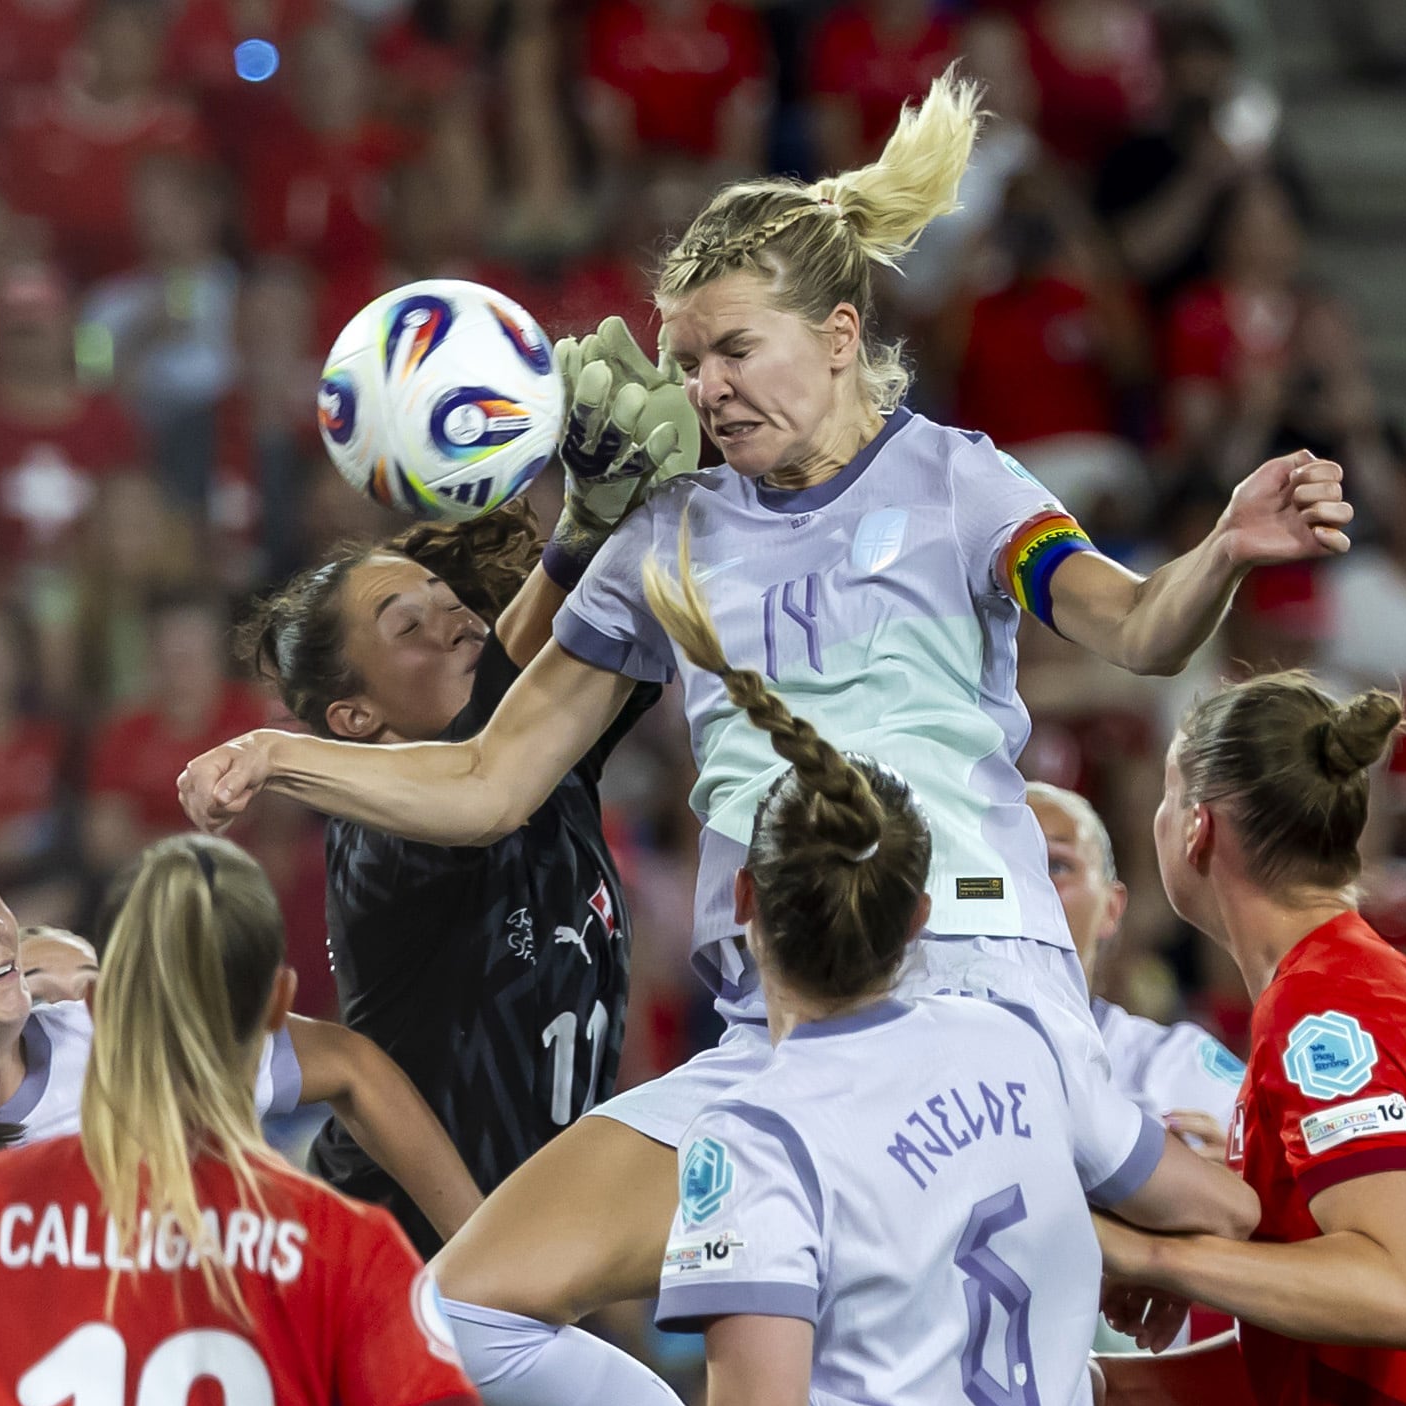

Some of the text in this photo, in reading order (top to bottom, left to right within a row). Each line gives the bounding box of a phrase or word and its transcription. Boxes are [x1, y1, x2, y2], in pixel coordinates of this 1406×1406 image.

[761, 571, 823, 684] 14
[542, 1000, 609, 1125] 11
[887, 1081, 1032, 1190] MJELDE
